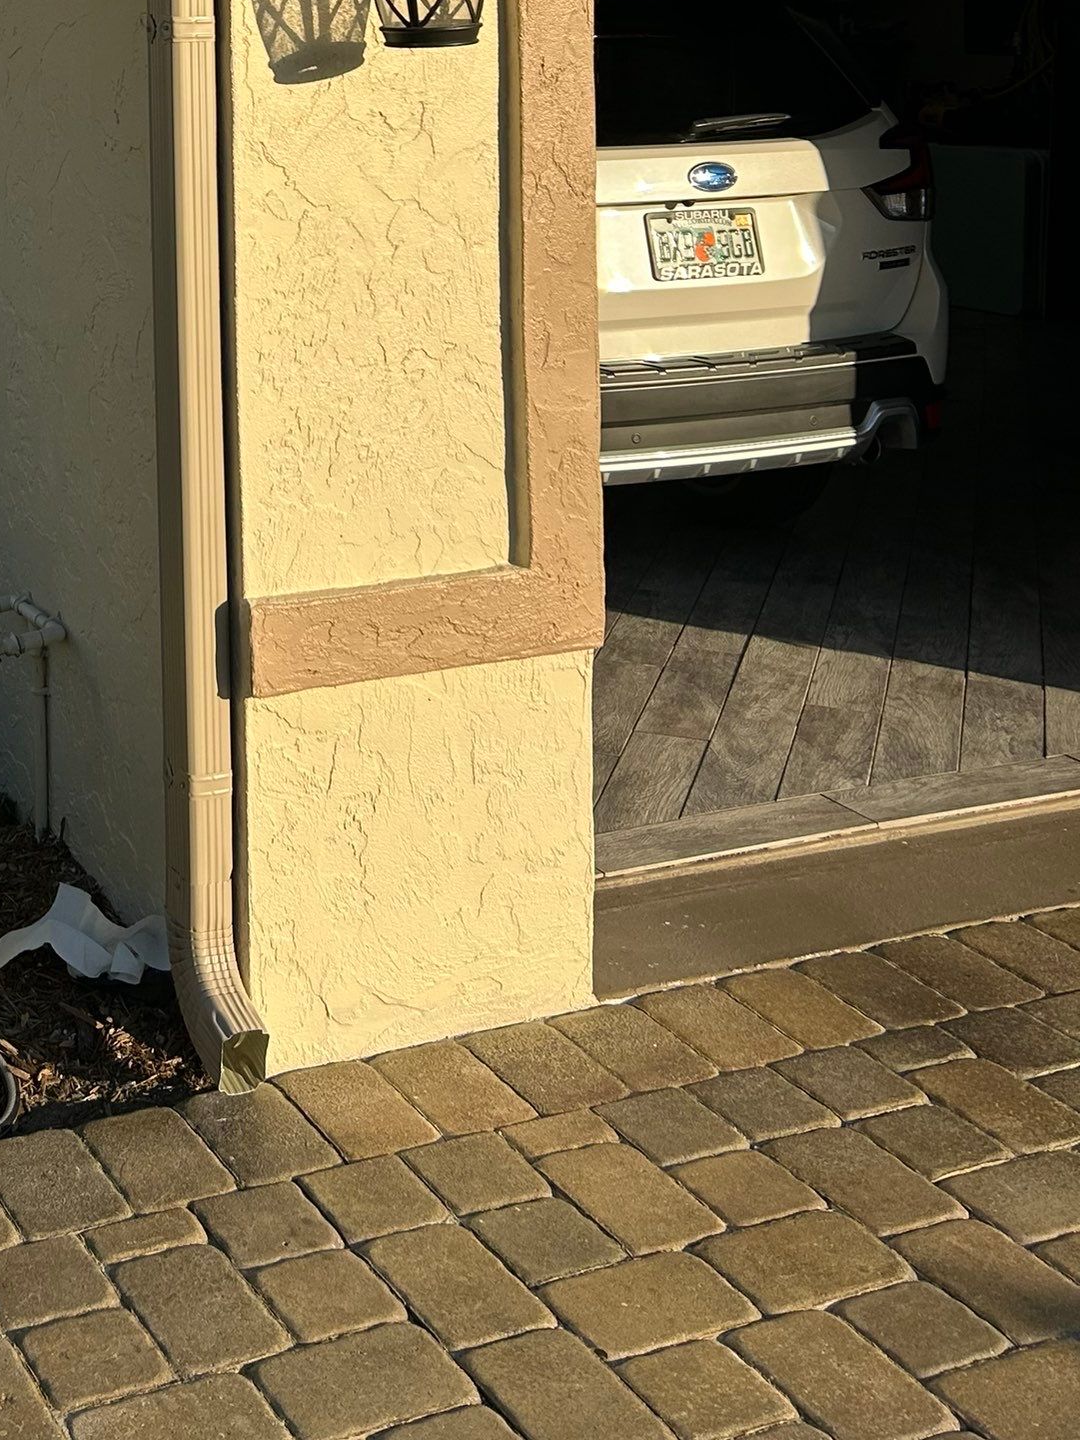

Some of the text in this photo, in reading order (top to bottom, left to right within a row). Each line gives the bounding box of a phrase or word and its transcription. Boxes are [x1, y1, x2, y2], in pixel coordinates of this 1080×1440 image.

[675, 209, 729, 220] SUBARU
[862, 245, 916, 260] FORESTER
[660, 262, 762, 281] SARASOTA
